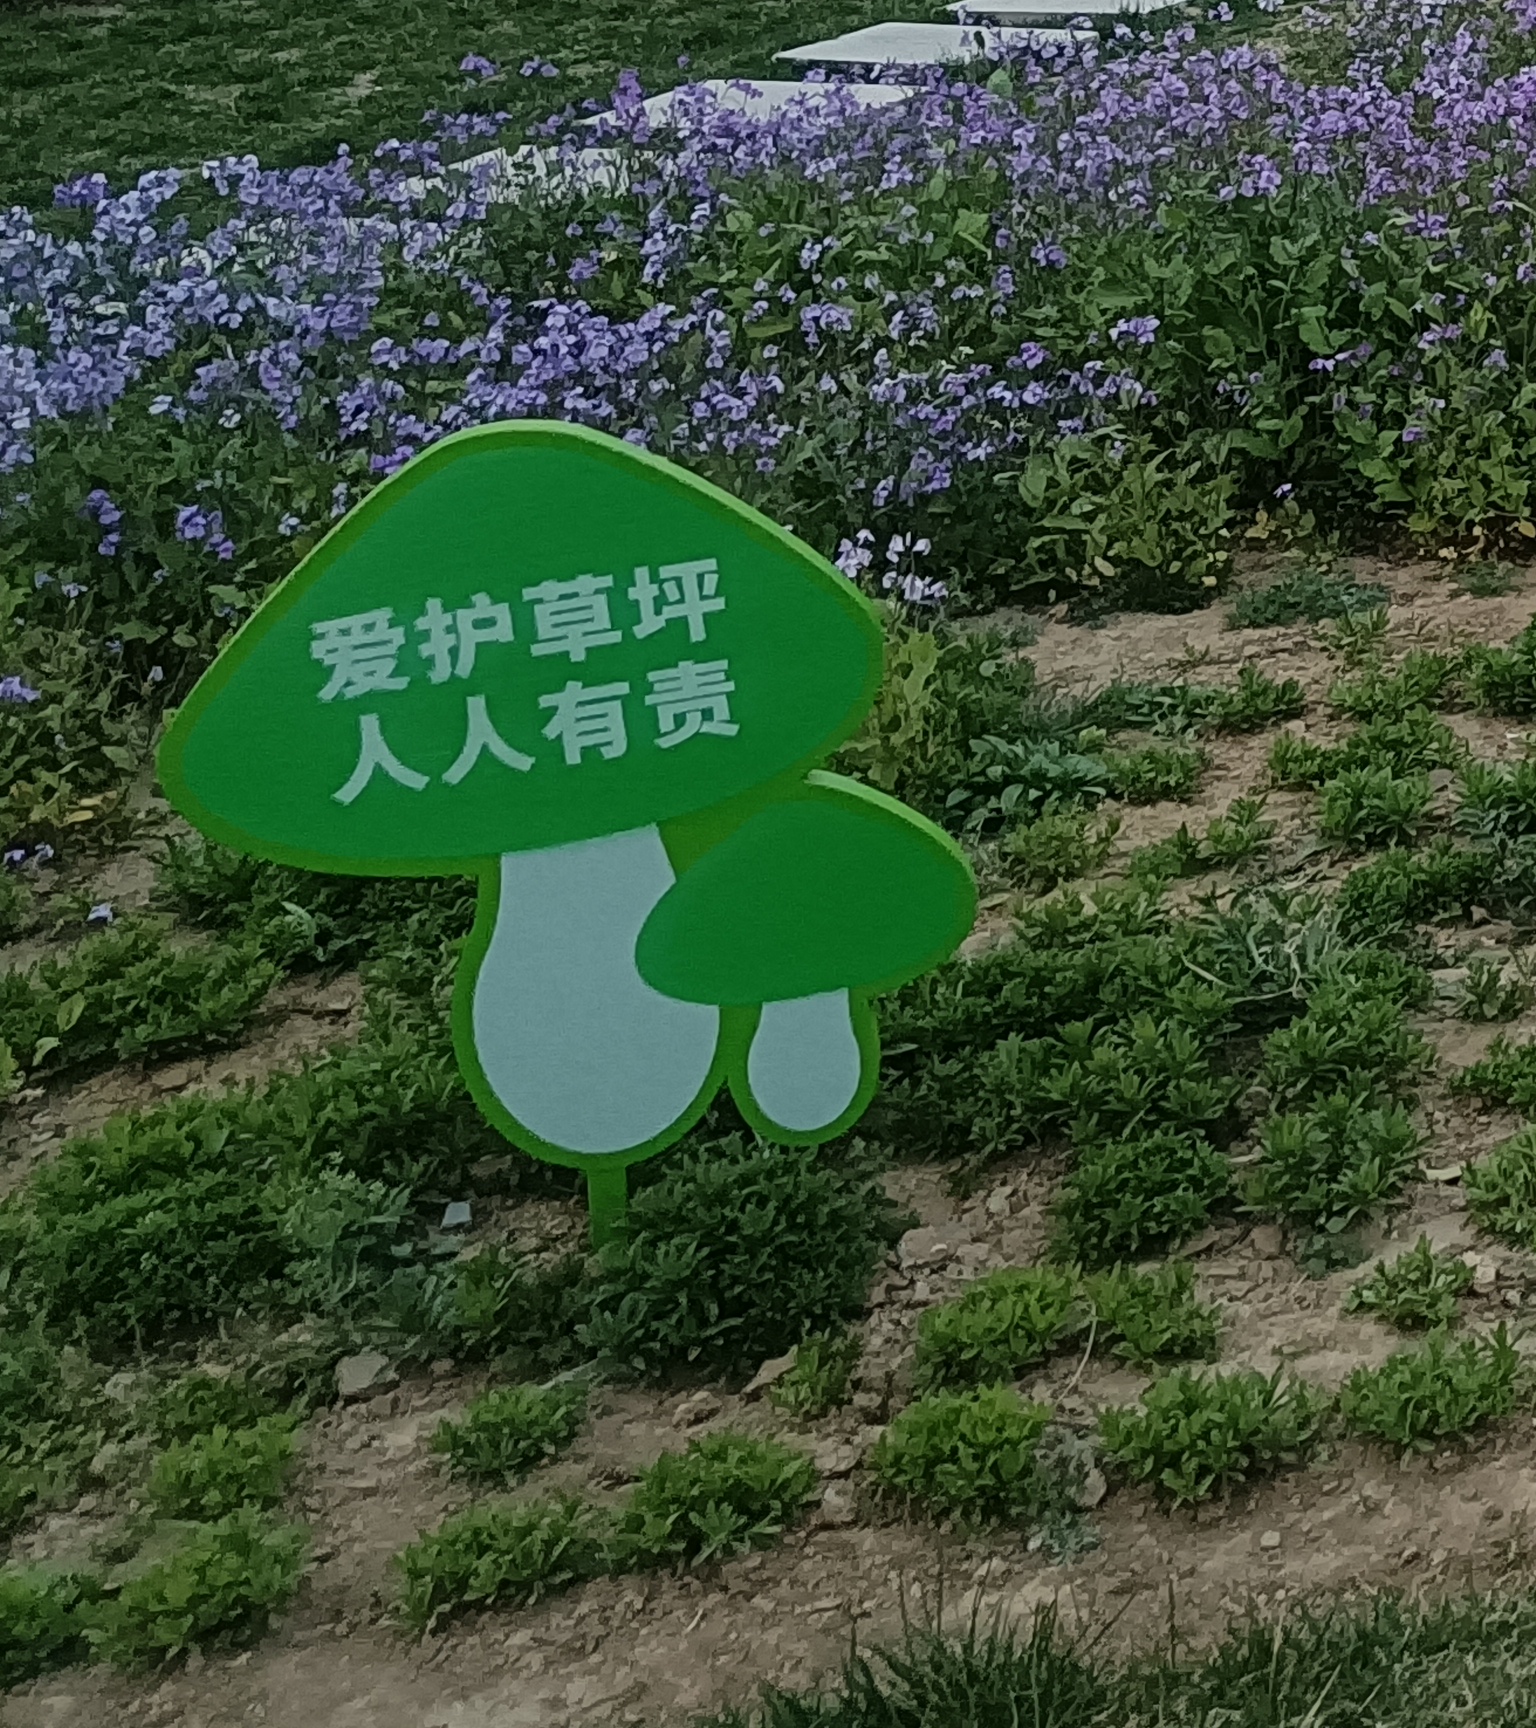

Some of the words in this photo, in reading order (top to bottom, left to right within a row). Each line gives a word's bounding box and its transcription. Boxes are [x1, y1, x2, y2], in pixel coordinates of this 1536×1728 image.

[310, 558, 726, 703] 爱护草坪
[331, 659, 740, 805] 人人有责
